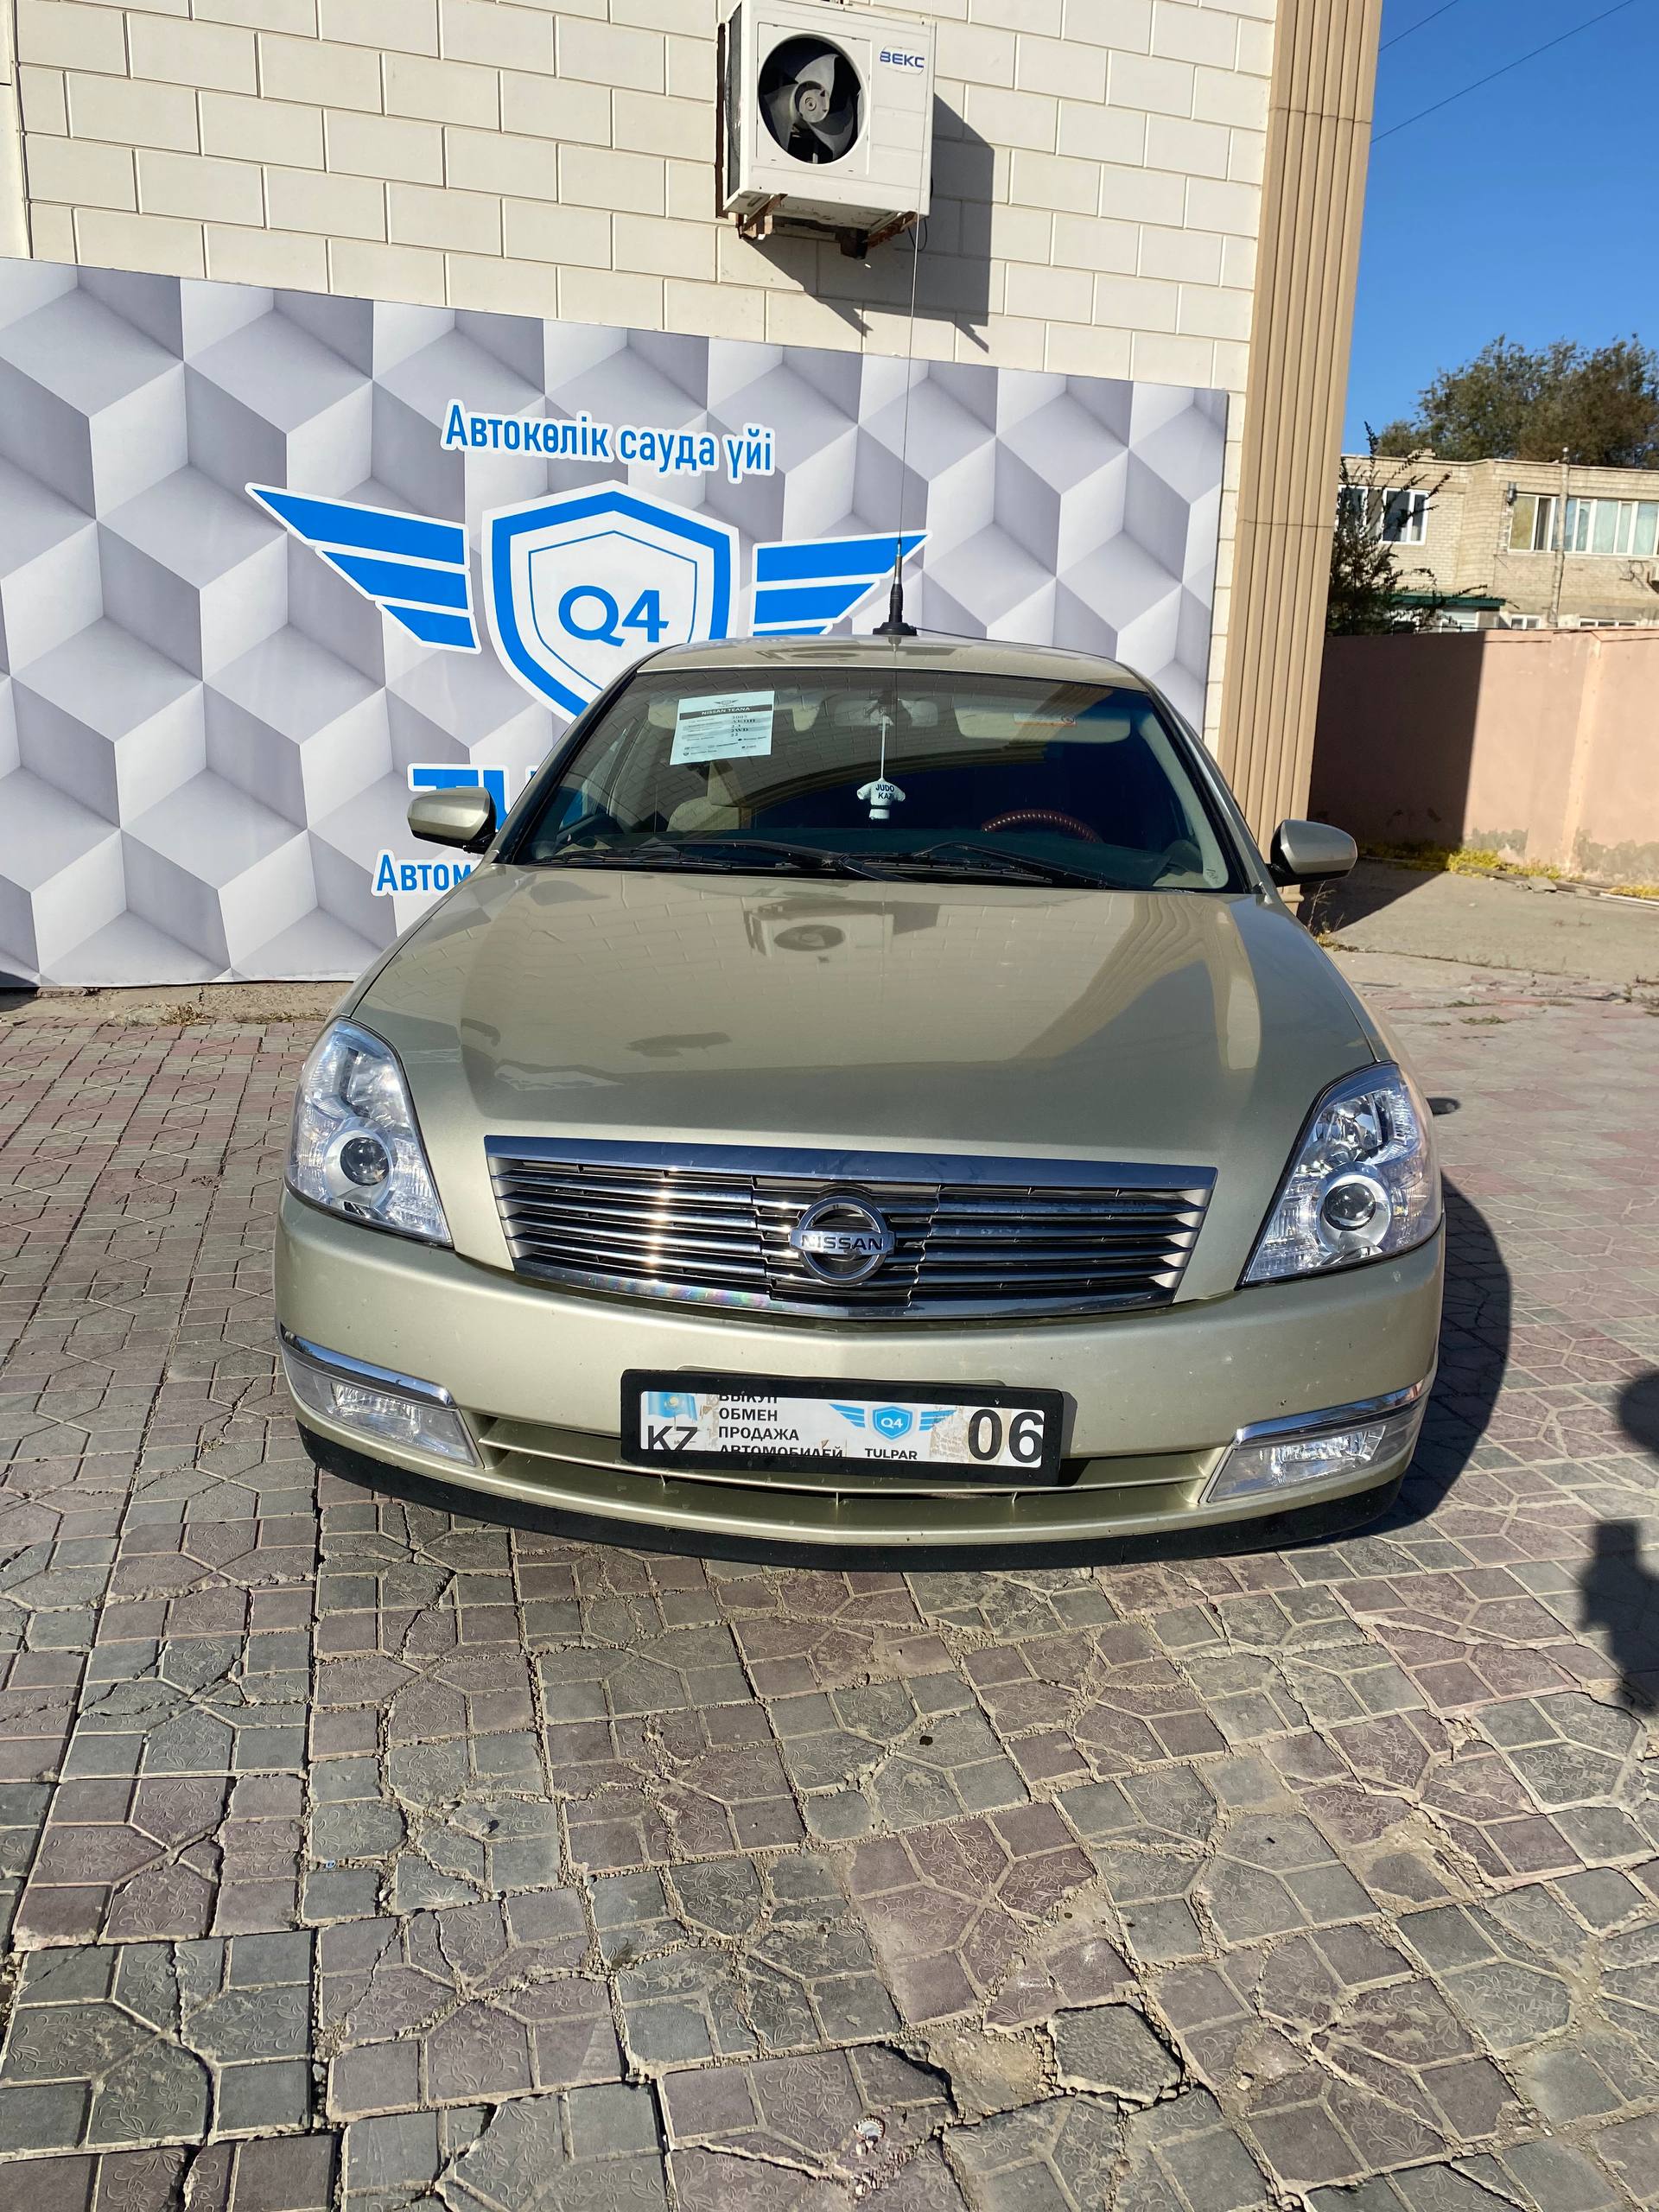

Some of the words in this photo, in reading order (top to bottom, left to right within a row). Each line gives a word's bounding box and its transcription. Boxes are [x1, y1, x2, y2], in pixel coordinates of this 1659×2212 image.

[446, 404, 609, 458] Автокөлік
[620, 429, 715, 473] сауда
[727, 429, 772, 478] үйі
[558, 585, 670, 647] Q4
[802, 1235, 882, 1250] NISSAN
[719, 1408, 778, 1421] ОБМЕН
[880, 1417, 903, 1428] Q4
[719, 1426, 800, 1441] ПРОДАЖА
[969, 1409, 1044, 1464] 06
[865, 1448, 918, 1460] TULPAR
